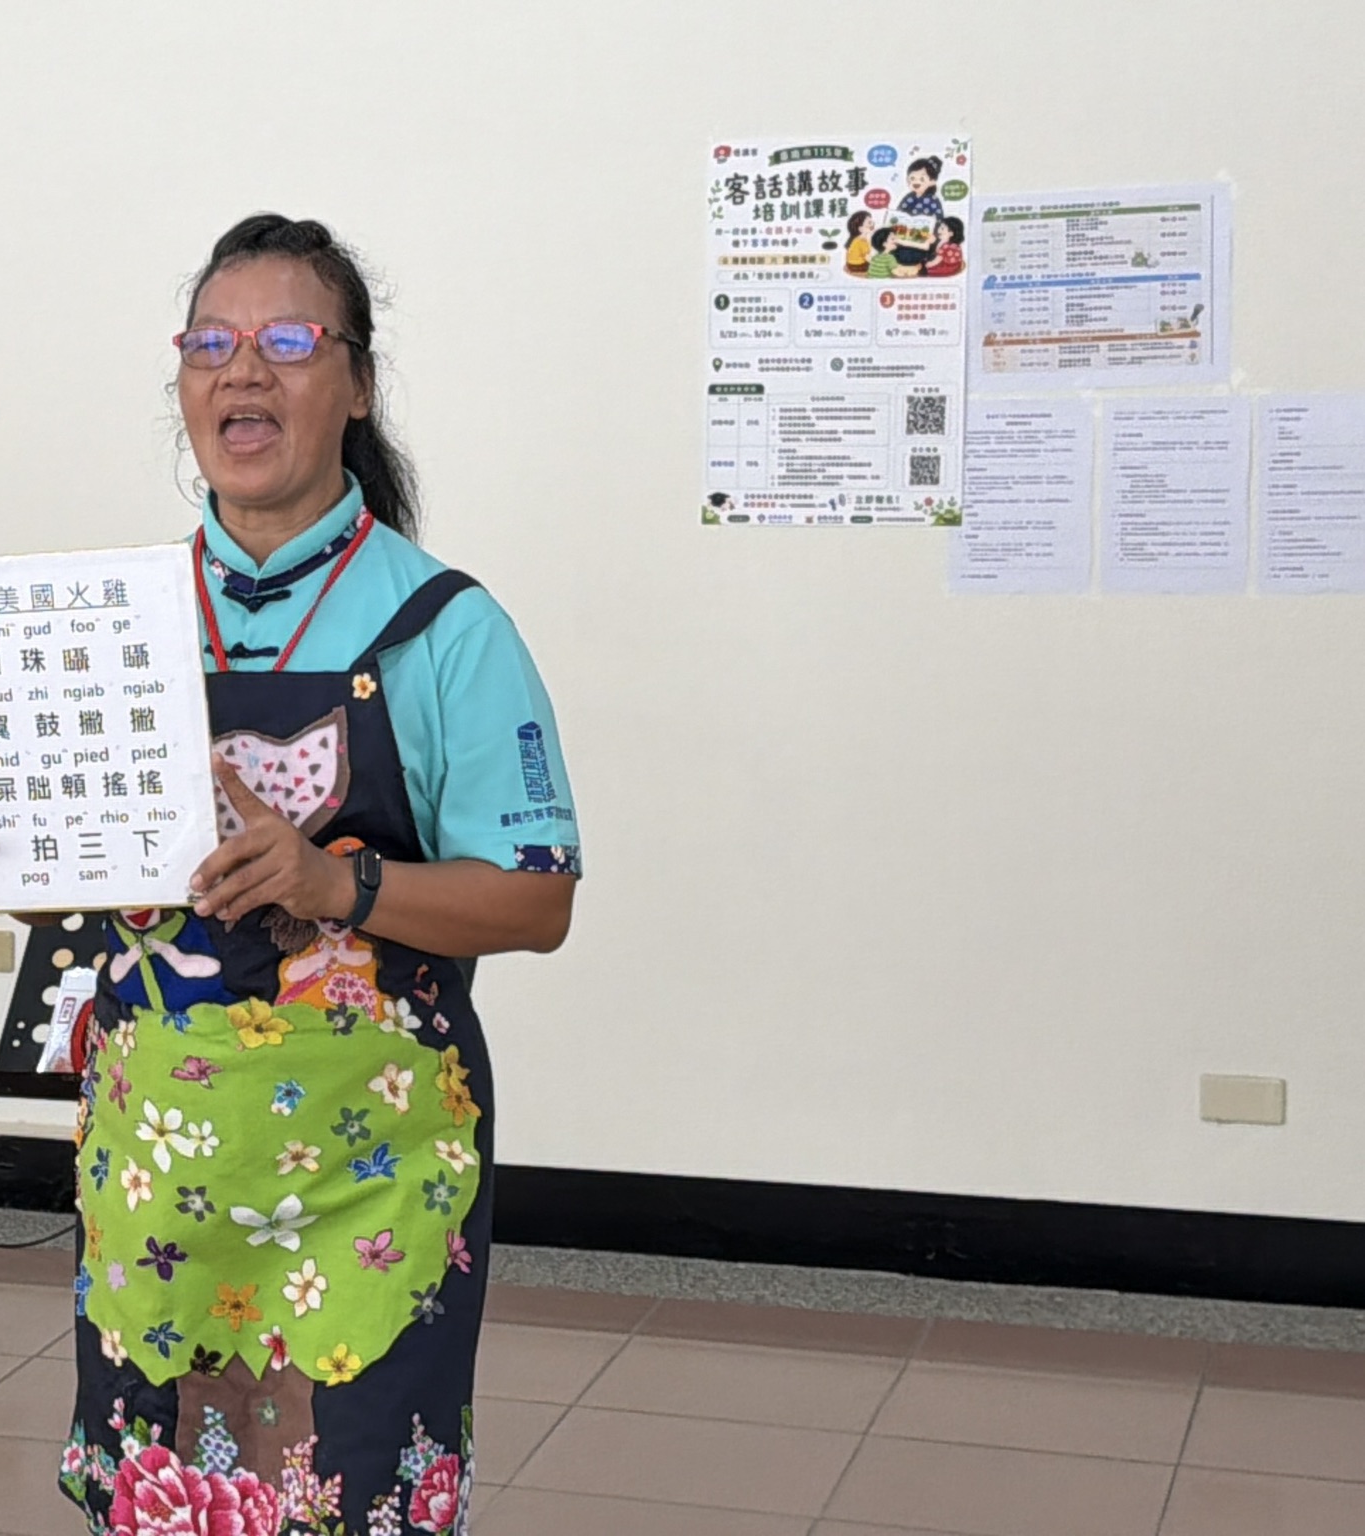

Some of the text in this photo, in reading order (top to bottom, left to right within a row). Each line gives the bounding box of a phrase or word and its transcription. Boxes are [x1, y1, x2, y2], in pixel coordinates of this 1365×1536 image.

[723, 166, 869, 205] 客話講故事
[752, 197, 849, 222] 培訓課程
[27, 685, 49, 701] zhi
